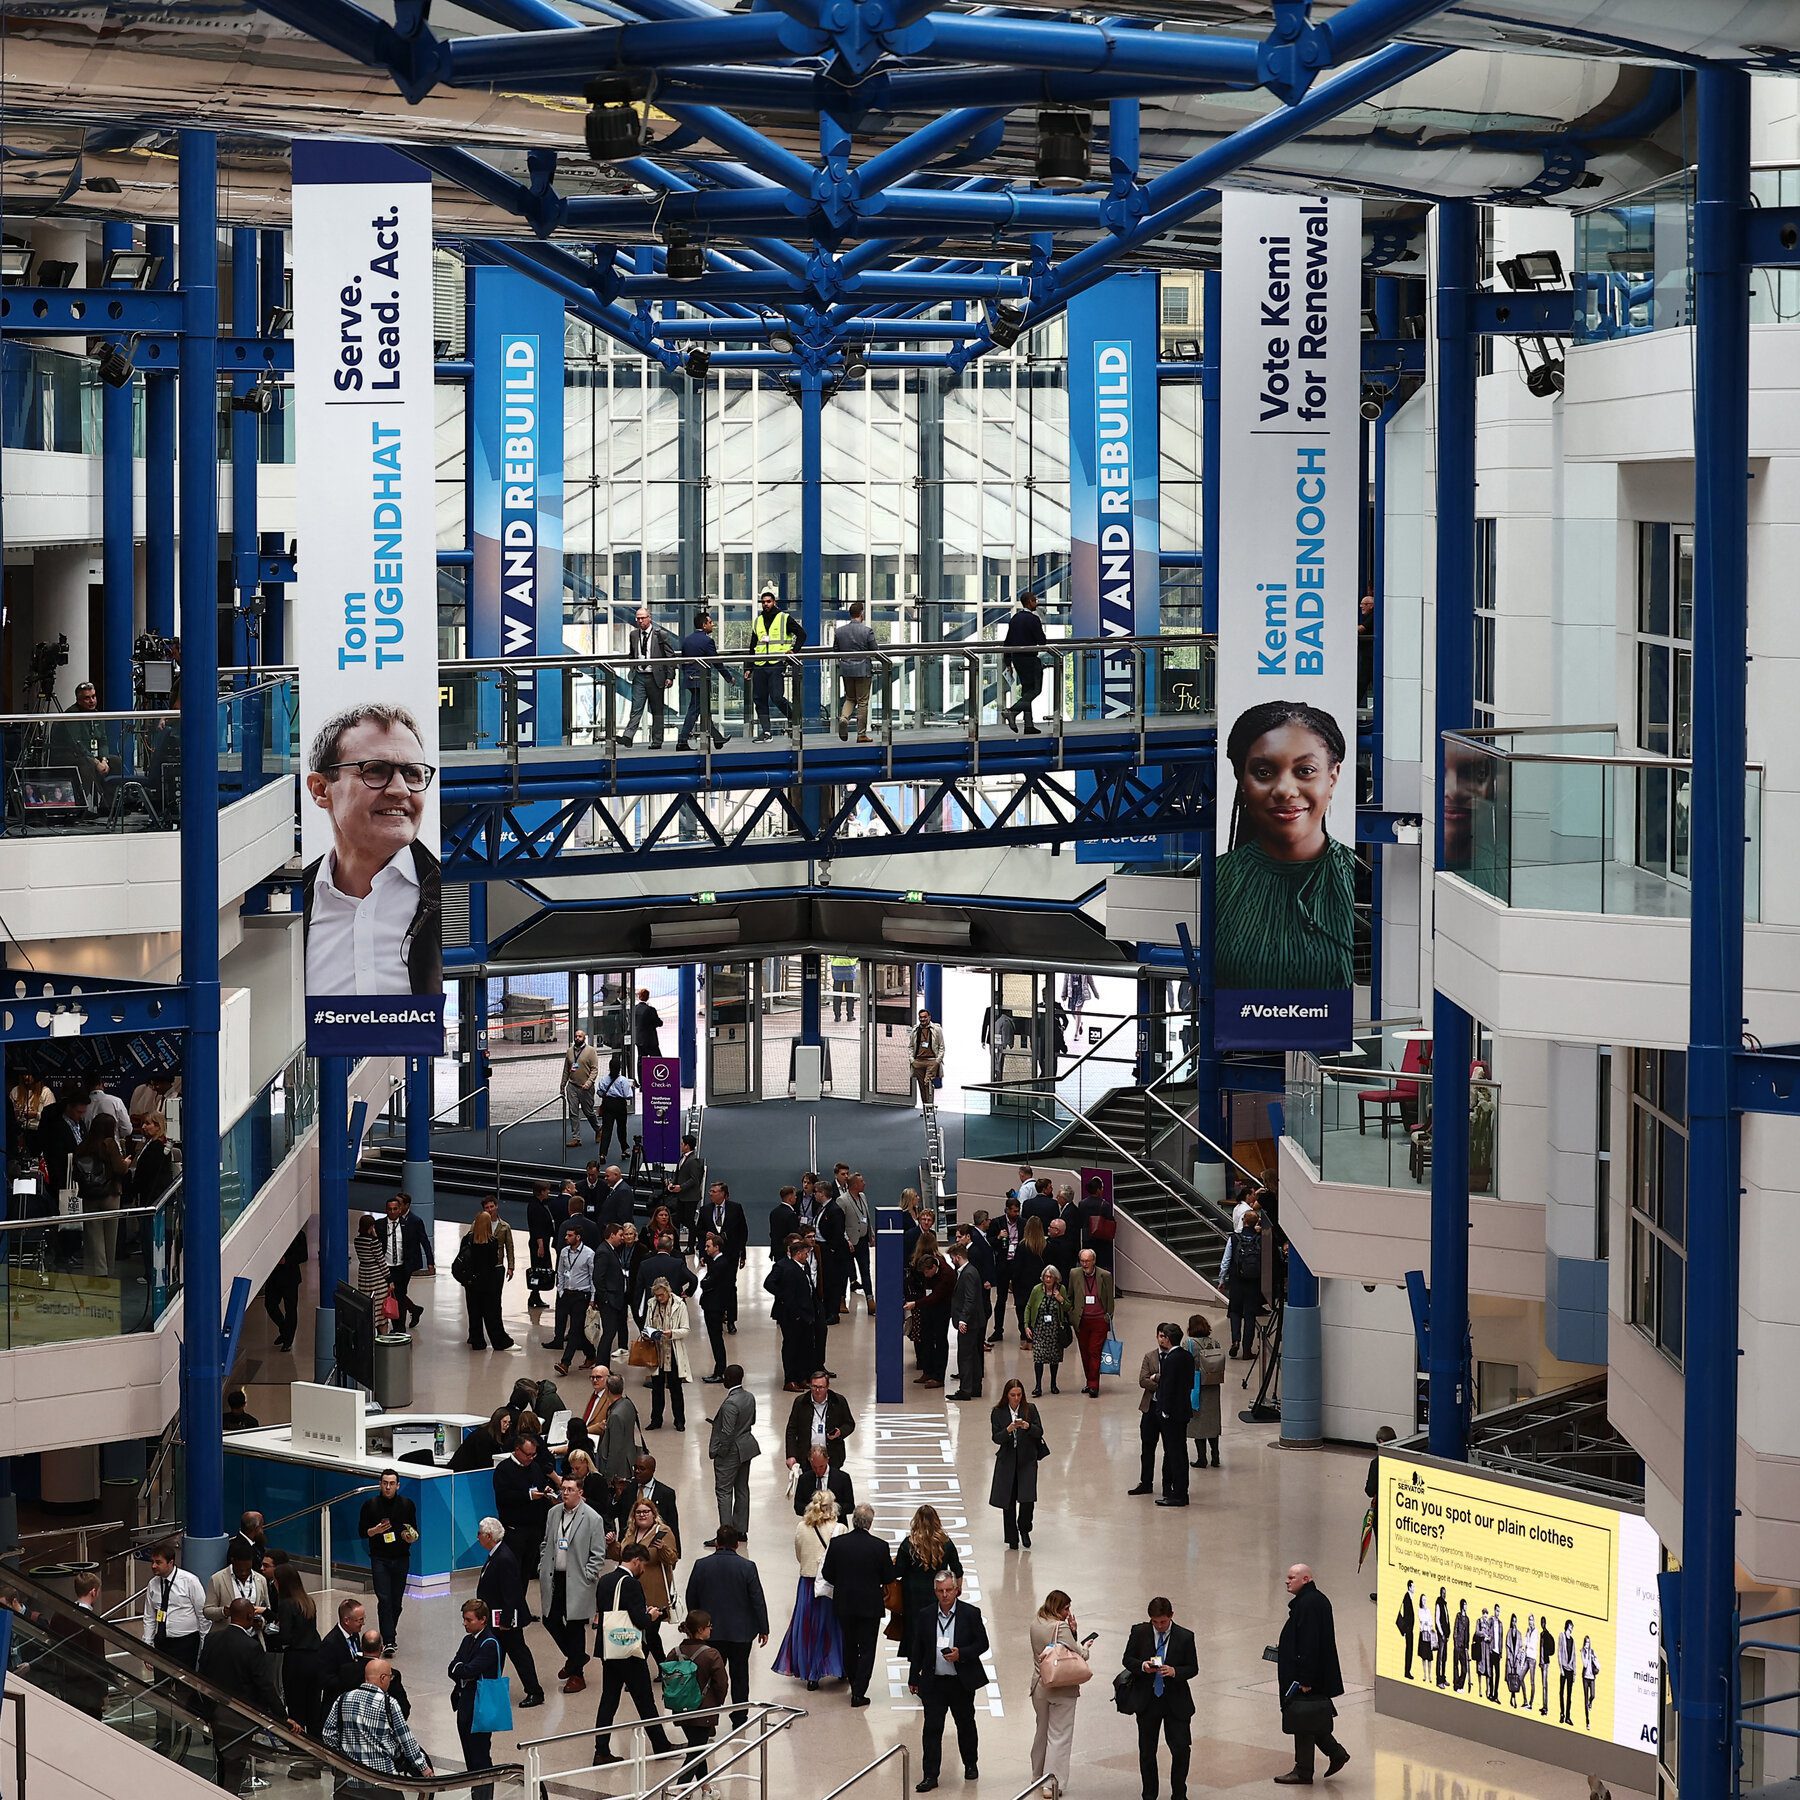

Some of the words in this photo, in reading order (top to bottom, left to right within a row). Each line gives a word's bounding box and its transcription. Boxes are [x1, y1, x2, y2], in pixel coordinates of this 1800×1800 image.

[370, 205, 400, 280] Act.
[1259, 236, 1291, 326] Kemi
[1298, 196, 1328, 359] Renewal.
[334, 275, 363, 392] Serve.
[370, 291, 401, 390] Lead.
[1260, 337, 1290, 422] Vote
[1297, 370, 1327, 422] for
[504, 341, 535, 509] REBUILD
[1098, 346, 1130, 514] REBUILD
[372, 421, 404, 670] TUGENDHAT
[504, 520, 535, 608] AND
[1100, 524, 1132, 611] AND
[1295, 448, 1326, 675] BADENOCH
[338, 592, 367, 671] Tom
[1256, 583, 1288, 675] Kemi
[313, 1010, 436, 1024] #ServeLeadAct
[1240, 1004, 1329, 1018] #VoteKemi
[860, 1413, 965, 1511] MATTHEW
[1397, 1482, 1425, 1495] SERVATOR
[1396, 1492, 1418, 1510] Can
[1421, 1501, 1443, 1517] you
[1445, 1506, 1471, 1524] spot
[1474, 1514, 1495, 1529] our
[1497, 1517, 1526, 1537] plain
[1529, 1525, 1574, 1549] clothes
[1396, 1516, 1445, 1540] officers?
[1398, 1562, 1421, 1576] Together,
[1437, 1573, 1446, 1582] got
[1451, 1577, 1473, 1589] covered
[1642, 1591, 1655, 1601] you
[1649, 1621, 1660, 1636] C
